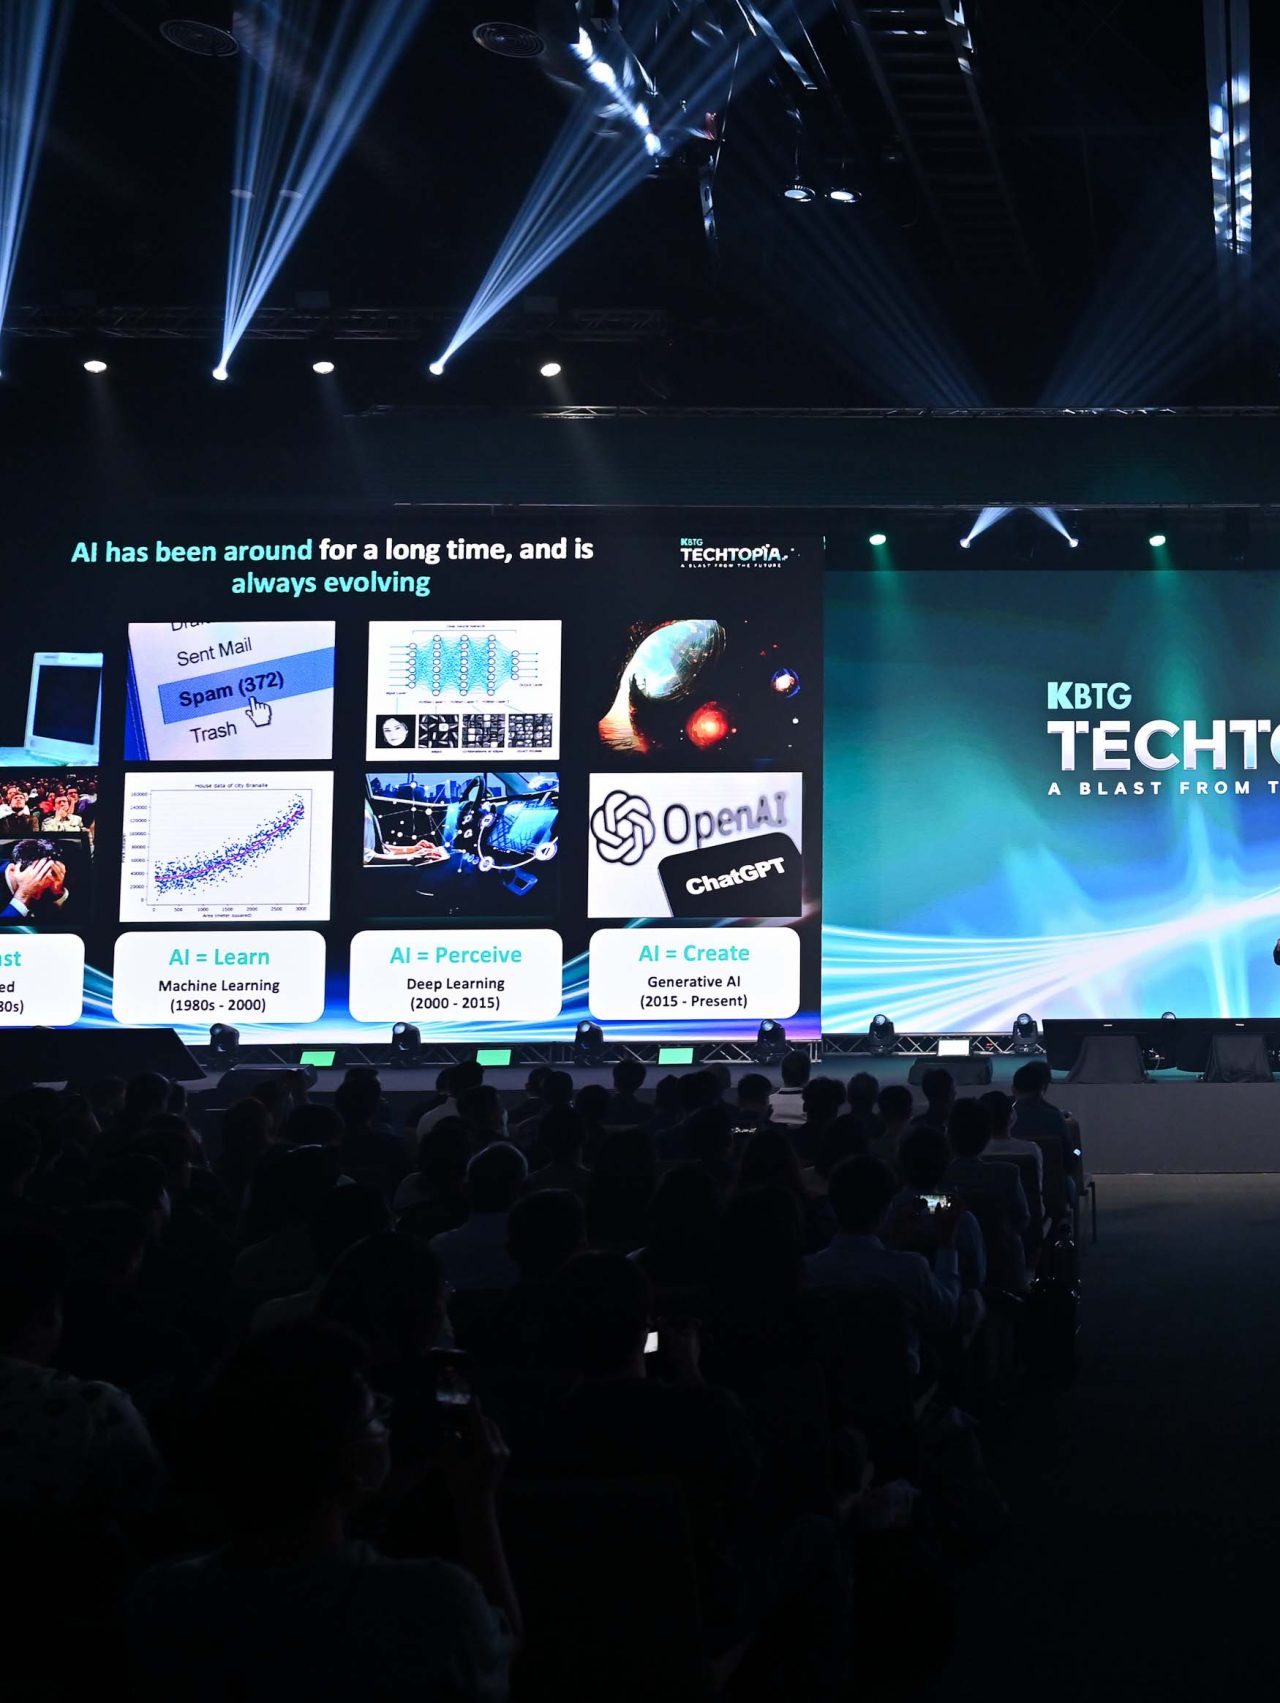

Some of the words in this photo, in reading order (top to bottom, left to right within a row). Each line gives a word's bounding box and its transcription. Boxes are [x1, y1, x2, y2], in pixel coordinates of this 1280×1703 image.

[71, 542, 97, 562] AI
[106, 541, 148, 562] has
[156, 541, 216, 562] been
[224, 539, 312, 561] around
[319, 538, 356, 560] for
[364, 544, 378, 560] a
[386, 538, 440, 564] long
[446, 538, 512, 563] time,
[520, 537, 567, 559] and
[575, 538, 593, 559] is
[681, 538, 703, 546] KBTG
[680, 544, 781, 561] TECHTOPIA
[232, 572, 316, 597] always
[324, 571, 430, 597] evolving
[177, 646, 215, 666] Sent
[219, 637, 252, 657] Mail
[179, 685, 234, 708] Spam
[239, 670, 284, 698] (372)
[1048, 682, 1131, 709] KBTG
[190, 722, 237, 743] Trash
[1048, 783, 1060, 795] A
[1080, 782, 1161, 795] BLAST
[1180, 781, 1250, 795] FROM
[663, 791, 789, 849] OpenAI
[685, 856, 786, 896] ChatGPT
[0, 950, 22, 967] st
[169, 949, 189, 965] AI
[215, 949, 269, 965] Learn
[390, 947, 410, 963] AI
[436, 946, 521, 963] Perceive
[639, 945, 659, 961] AI
[684, 945, 749, 961] Create
[159, 980, 216, 991] Machine
[222, 980, 279, 993] Learning
[408, 979, 442, 992] Deep
[447, 978, 504, 991] Learning
[648, 976, 722, 987] Generative
[727, 976, 740, 987] AI
[171, 999, 215, 1013] (1980s
[228, 999, 265, 1013] 2000)
[411, 997, 449, 1011] (2000
[463, 997, 499, 1010] 2015)
[641, 995, 677, 1009] (2015
[692, 994, 747, 1008] Present)
